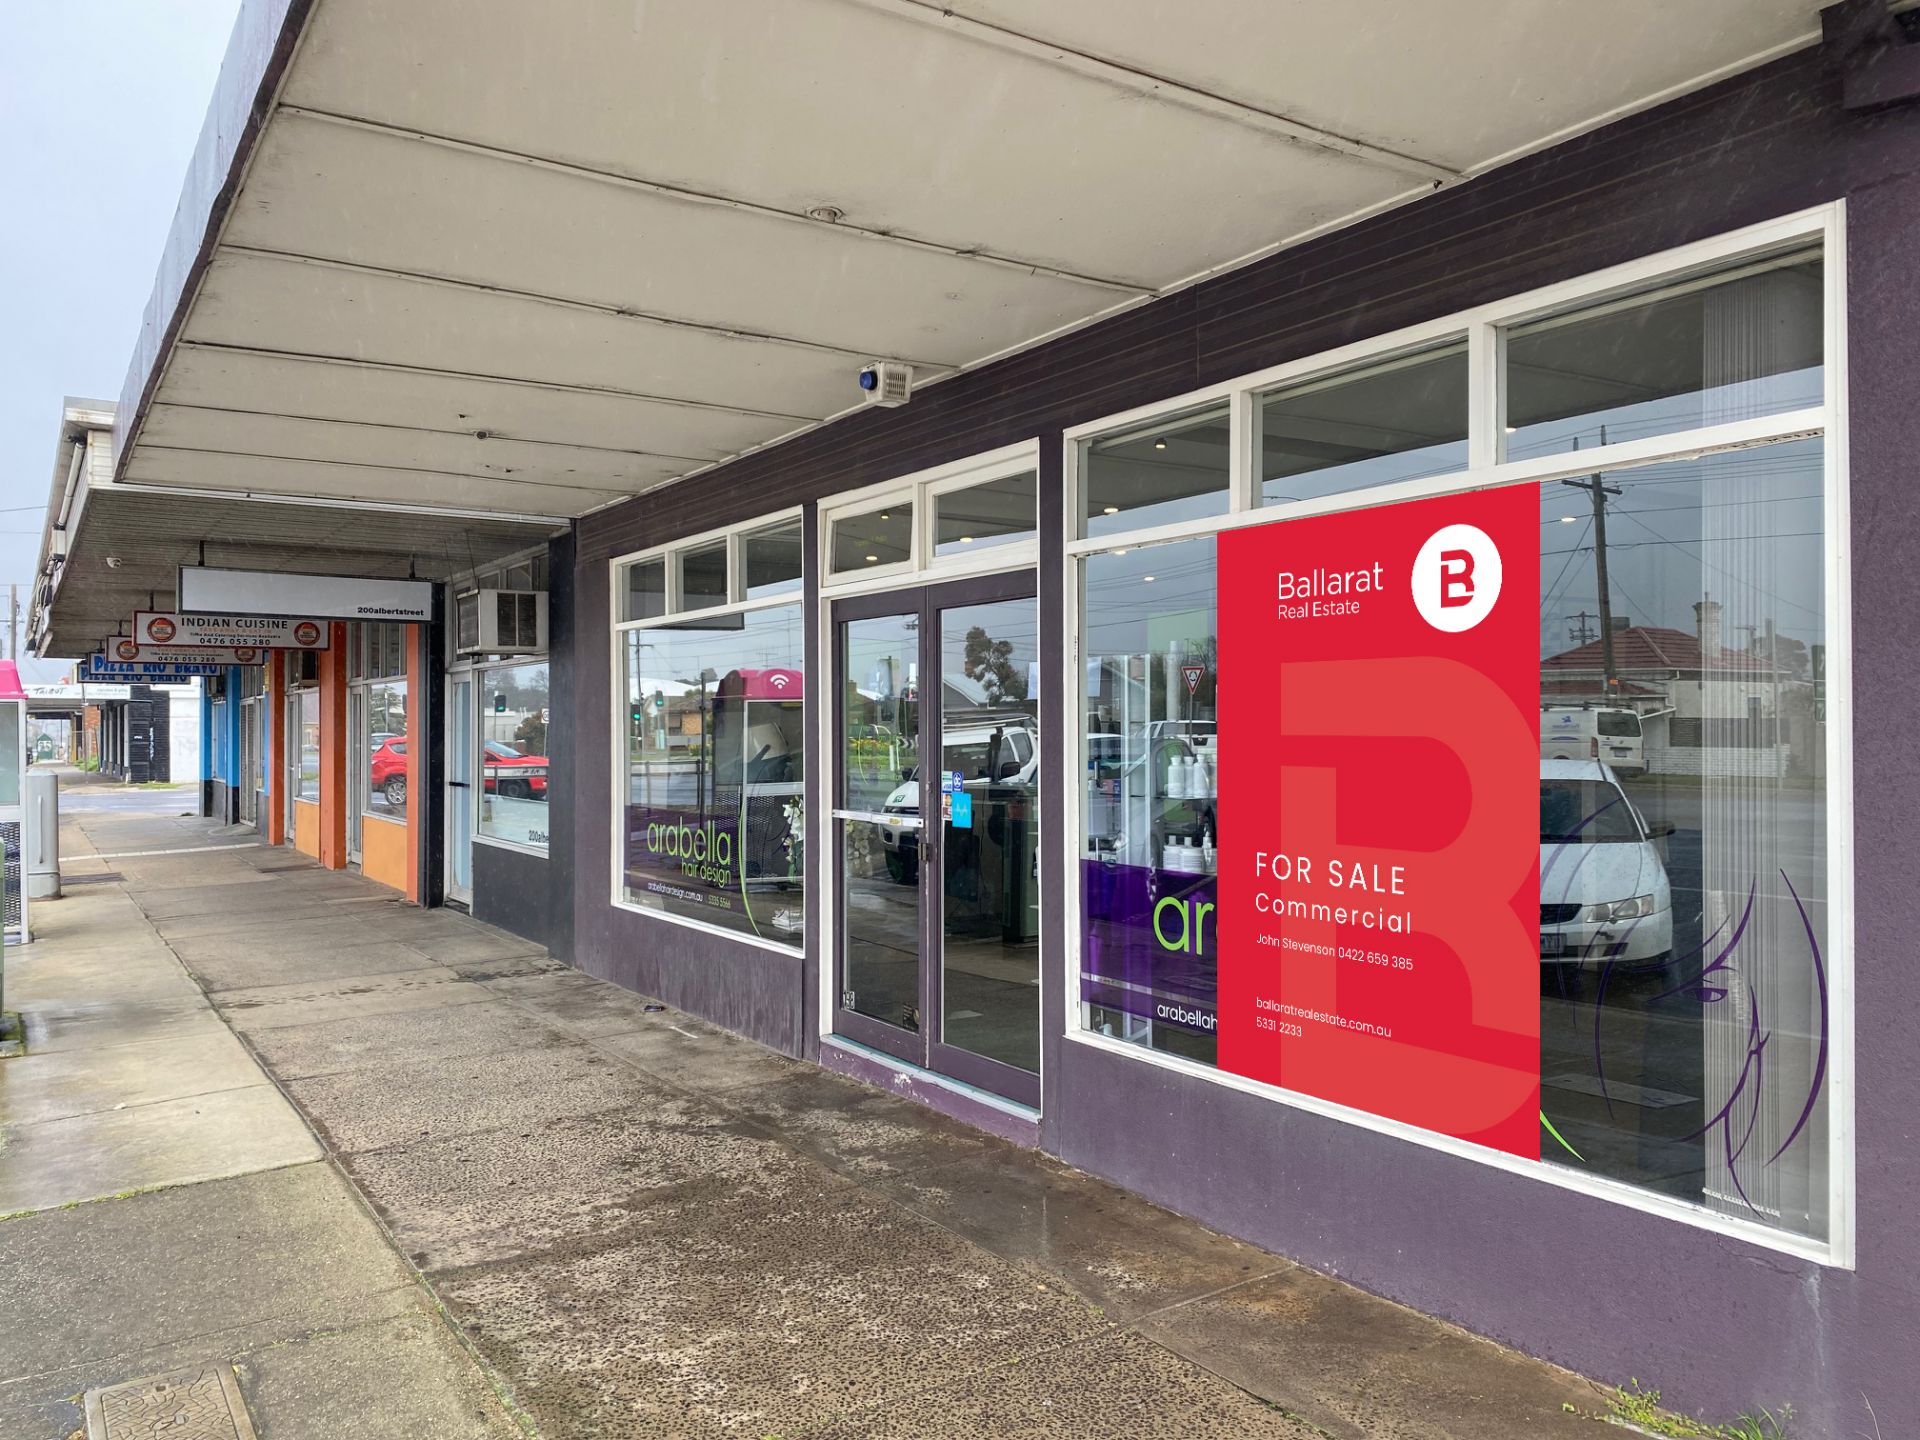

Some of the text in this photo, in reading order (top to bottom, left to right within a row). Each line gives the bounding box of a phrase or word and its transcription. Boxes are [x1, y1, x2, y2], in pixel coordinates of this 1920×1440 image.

[1278, 561, 1384, 600] Ballarat
[181, 617, 288, 629] INDIAN CUISINE
[357, 606, 424, 616] 200albertstreet
[1278, 600, 1360, 620] Real Estate
[647, 816, 730, 865] arabella
[681, 858, 731, 887] hair design
[1256, 852, 1405, 895] FOR SALE
[1255, 892, 1411, 934] Commercial
[1256, 933, 1414, 971] John Stevenson 0422 659 385
[1256, 996, 1392, 1038] ballaratrealestate.com.au
[1256, 1016, 1302, 1037] 5331 2233
